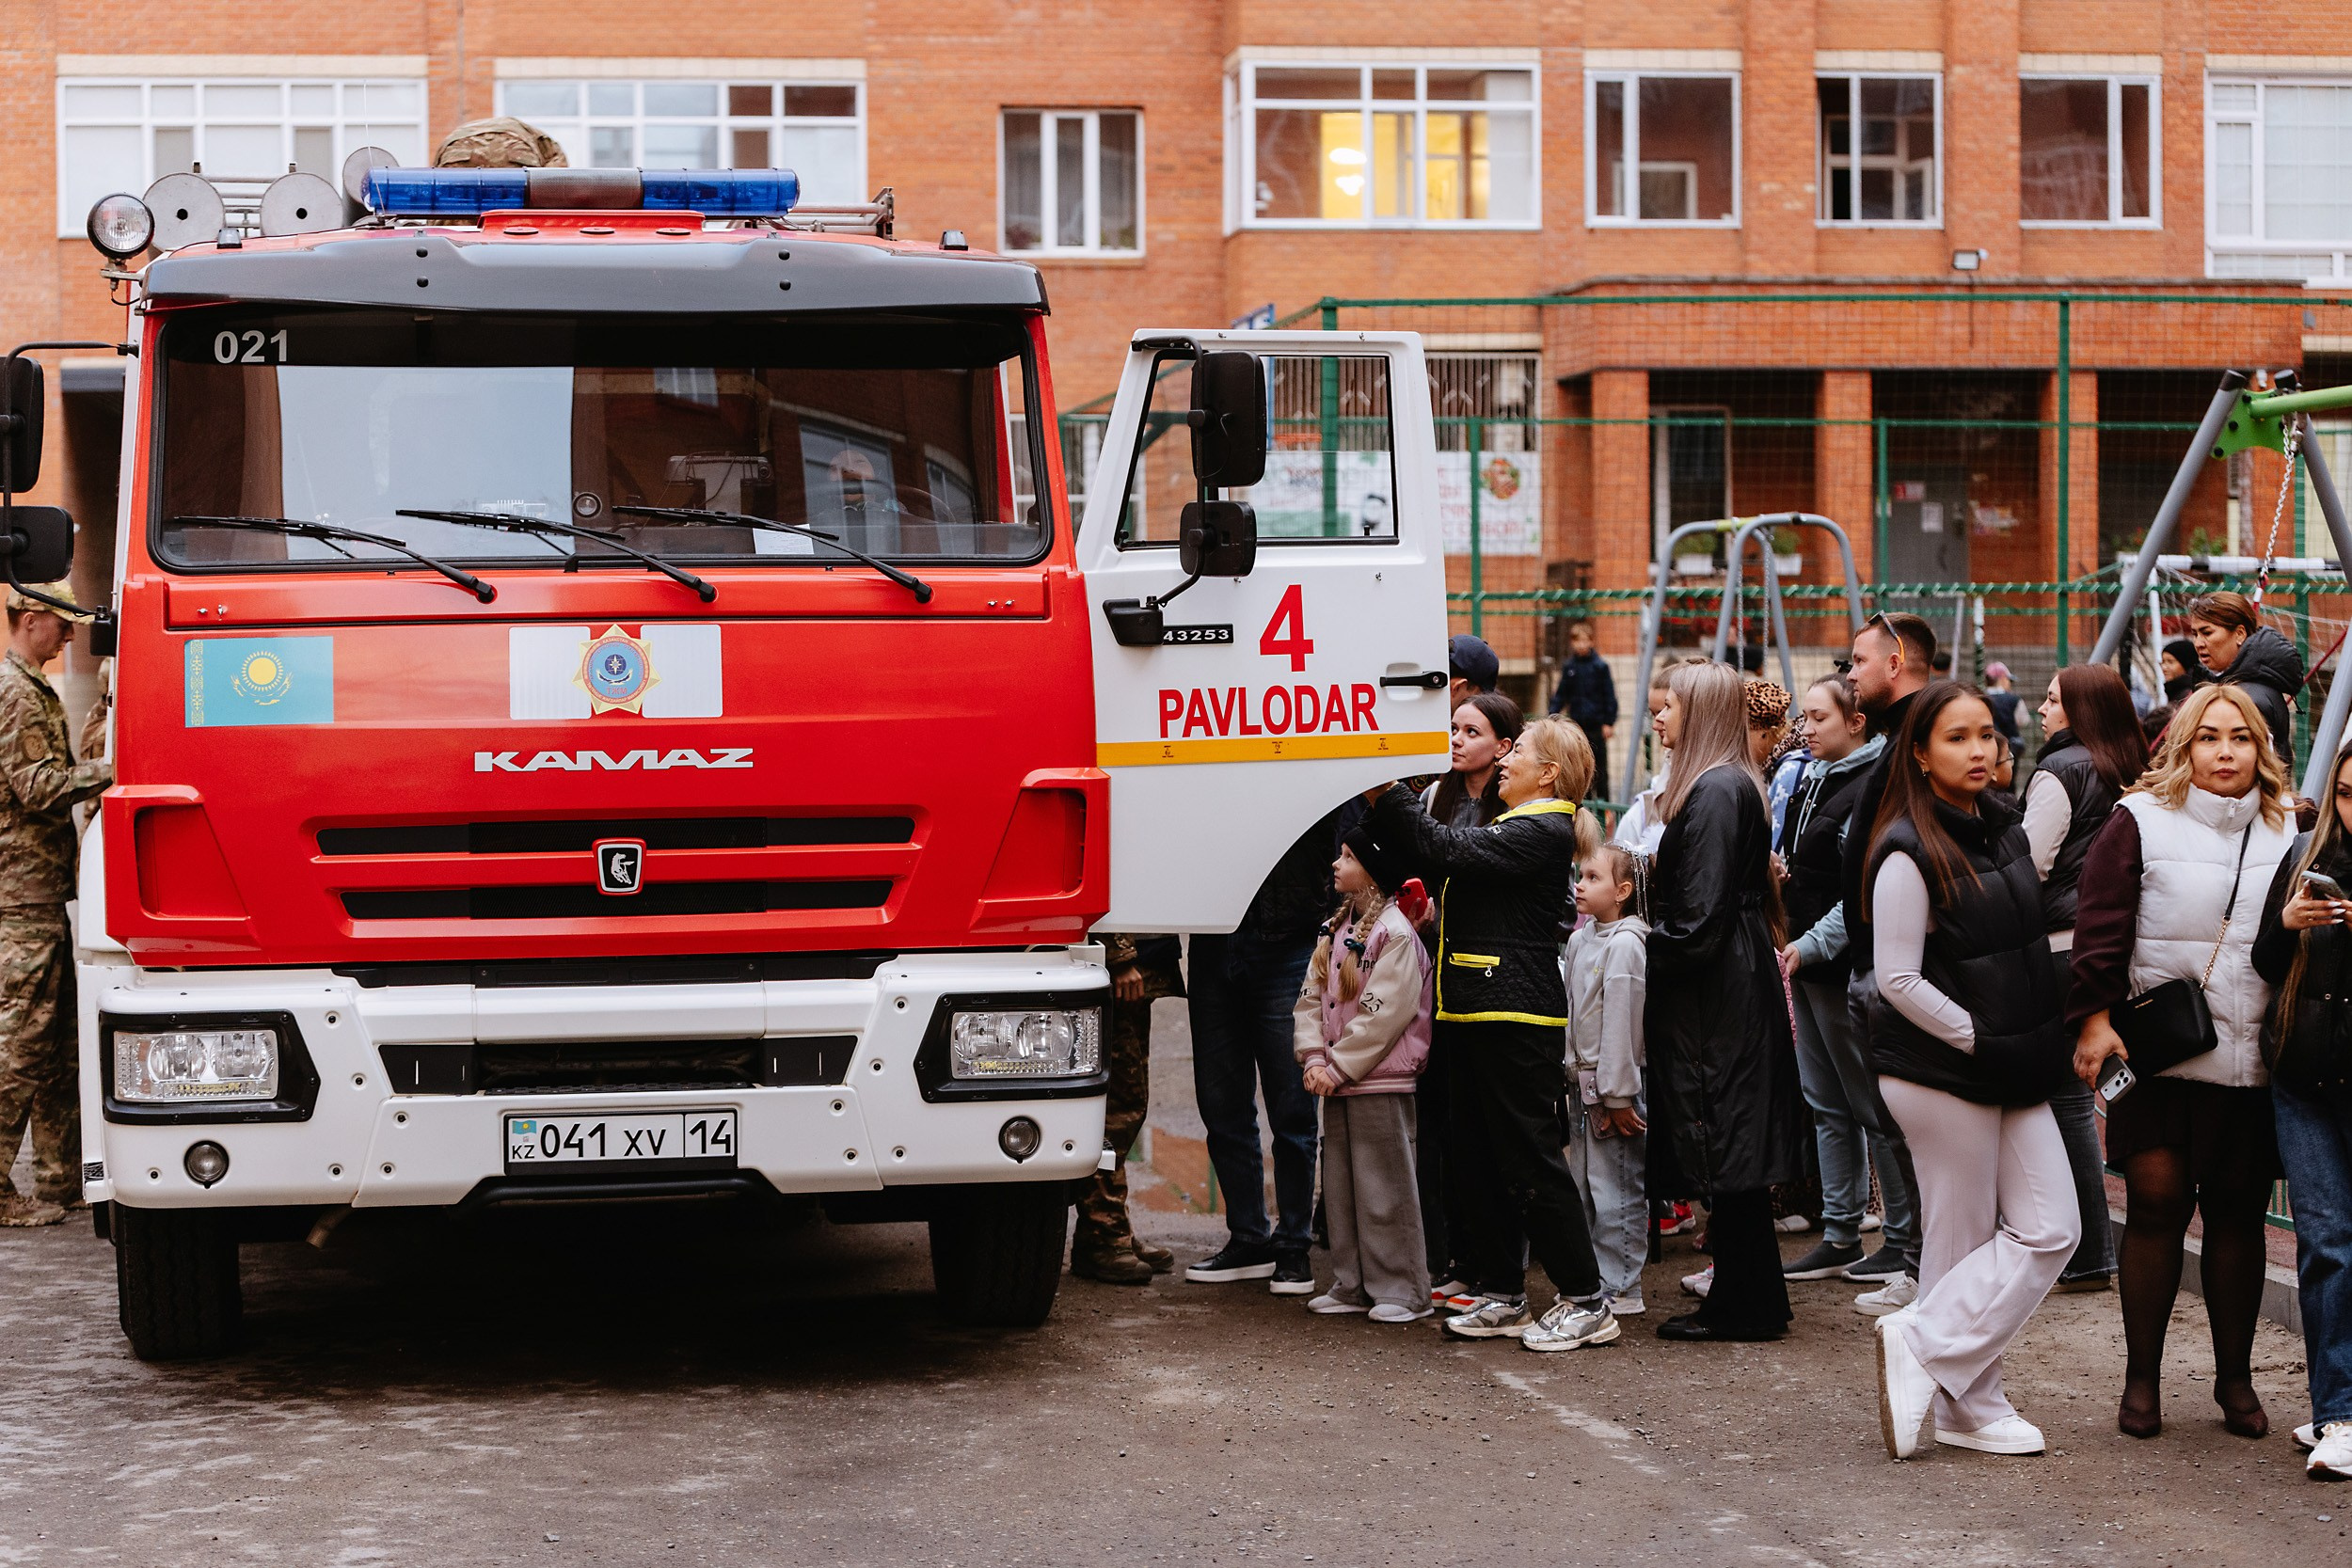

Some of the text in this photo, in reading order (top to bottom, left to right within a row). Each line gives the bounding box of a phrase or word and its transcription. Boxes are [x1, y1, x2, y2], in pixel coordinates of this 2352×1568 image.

[214, 329, 287, 364] 021
[1163, 628, 1230, 642] 43253
[1259, 584, 1314, 673] 4
[1158, 683, 1379, 738] PAVLODAR
[473, 748, 754, 772] KAMAZ
[512, 1119, 731, 1160] KZ 041 XV 14
